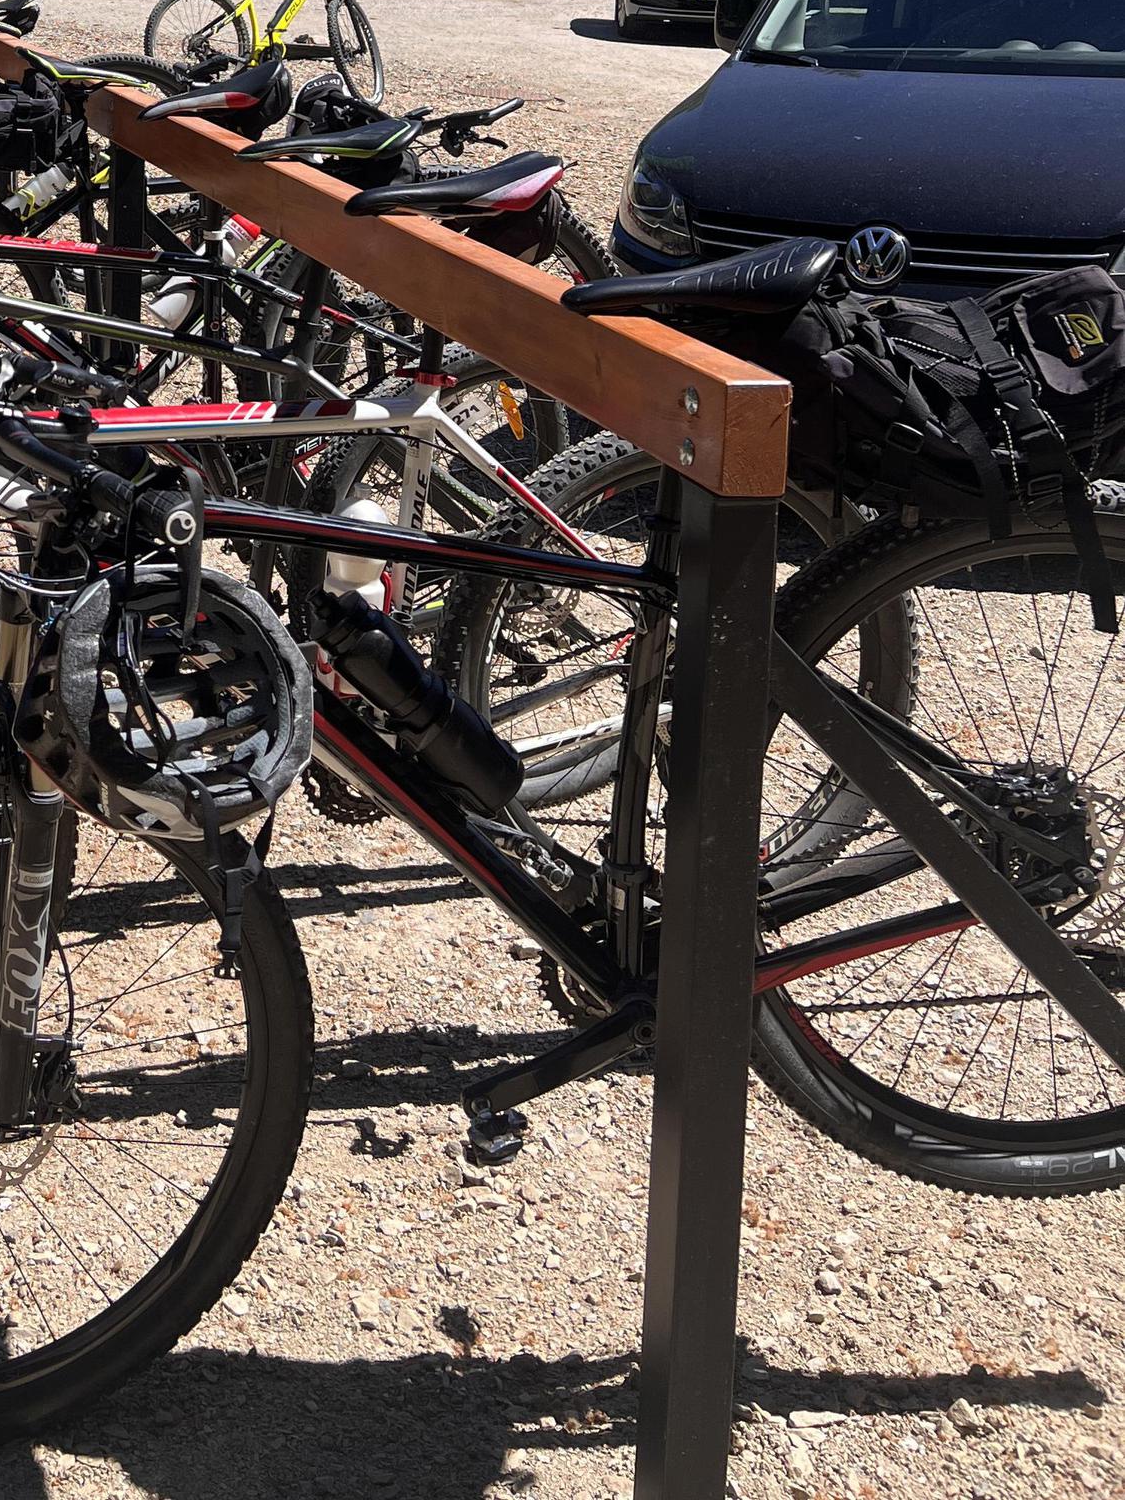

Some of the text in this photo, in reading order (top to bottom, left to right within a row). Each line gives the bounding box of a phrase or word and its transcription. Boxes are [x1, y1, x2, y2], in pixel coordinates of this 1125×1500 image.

[452, 405, 481, 425] 271
[0, 900, 50, 1036] FOX
[1048, 1154, 1093, 1176] 29
